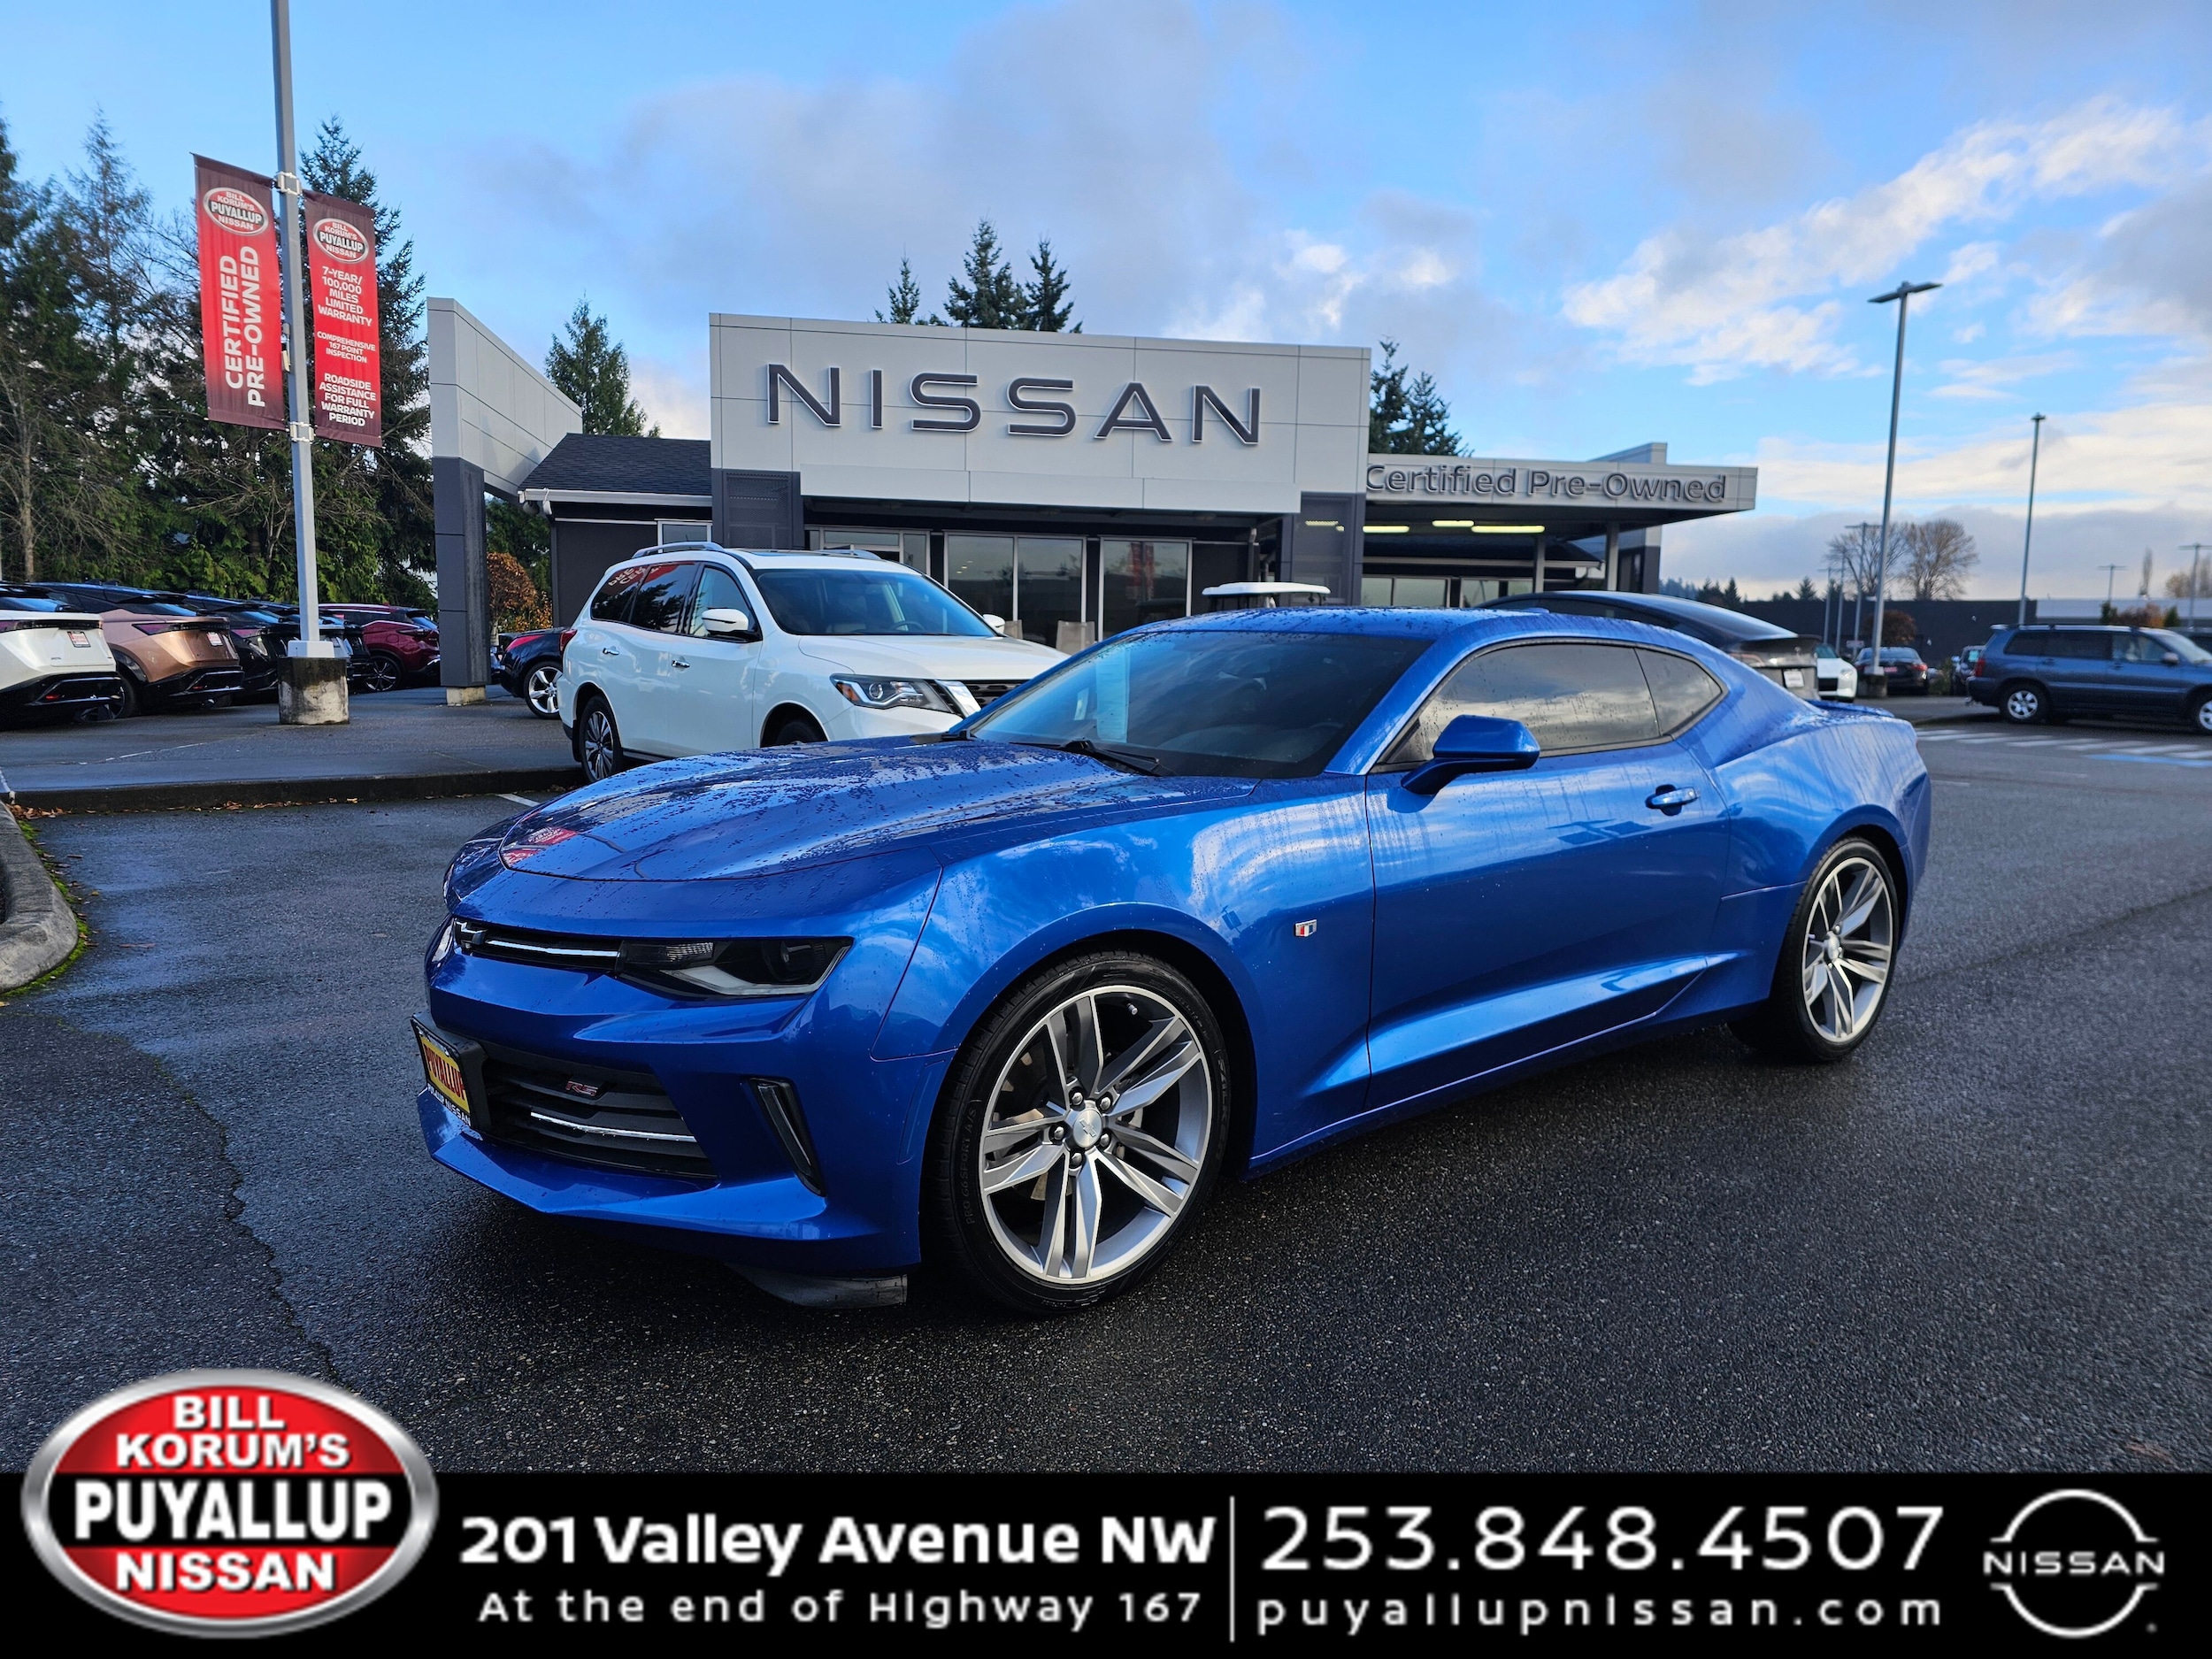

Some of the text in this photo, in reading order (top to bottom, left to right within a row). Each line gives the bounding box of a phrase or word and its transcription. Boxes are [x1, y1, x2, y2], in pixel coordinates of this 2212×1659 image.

[217, 196, 255, 211] KORUM'S
[227, 192, 244, 202] BILL
[211, 201, 263, 224] PUYALLUP
[218, 215, 254, 230] NISSAN
[332, 222, 349, 232] BILL
[319, 231, 364, 252] PUYALLUP
[324, 226, 357, 240] KORUM'S
[326, 244, 357, 258] NISSAN
[322, 265, 363, 285] 7-YEAR/
[321, 276, 362, 295] 100,000
[329, 288, 359, 303] MILES
[325, 296, 364, 314] LIMITED
[219, 255, 244, 389] CERTIFIED
[318, 304, 373, 326] WARRANTY
[240, 245, 265, 407] PRE-OWNED
[317, 331, 376, 351] COMPREHENSIVE
[342, 344, 364, 355] POINT
[326, 348, 367, 363] INSPECTION
[319, 381, 376, 401] ASSISTANCE
[324, 373, 372, 391] ROADSIDE
[324, 392, 370, 409] FOR FULL
[766, 363, 1261, 445] NISSAN
[321, 401, 375, 419] WARRANTY
[329, 411, 365, 426] PERIOD
[1366, 463, 1727, 504] Certified Pre-Owned
[565, 1080, 598, 1096] RS
[445, 1098, 472, 1127] NISSAN
